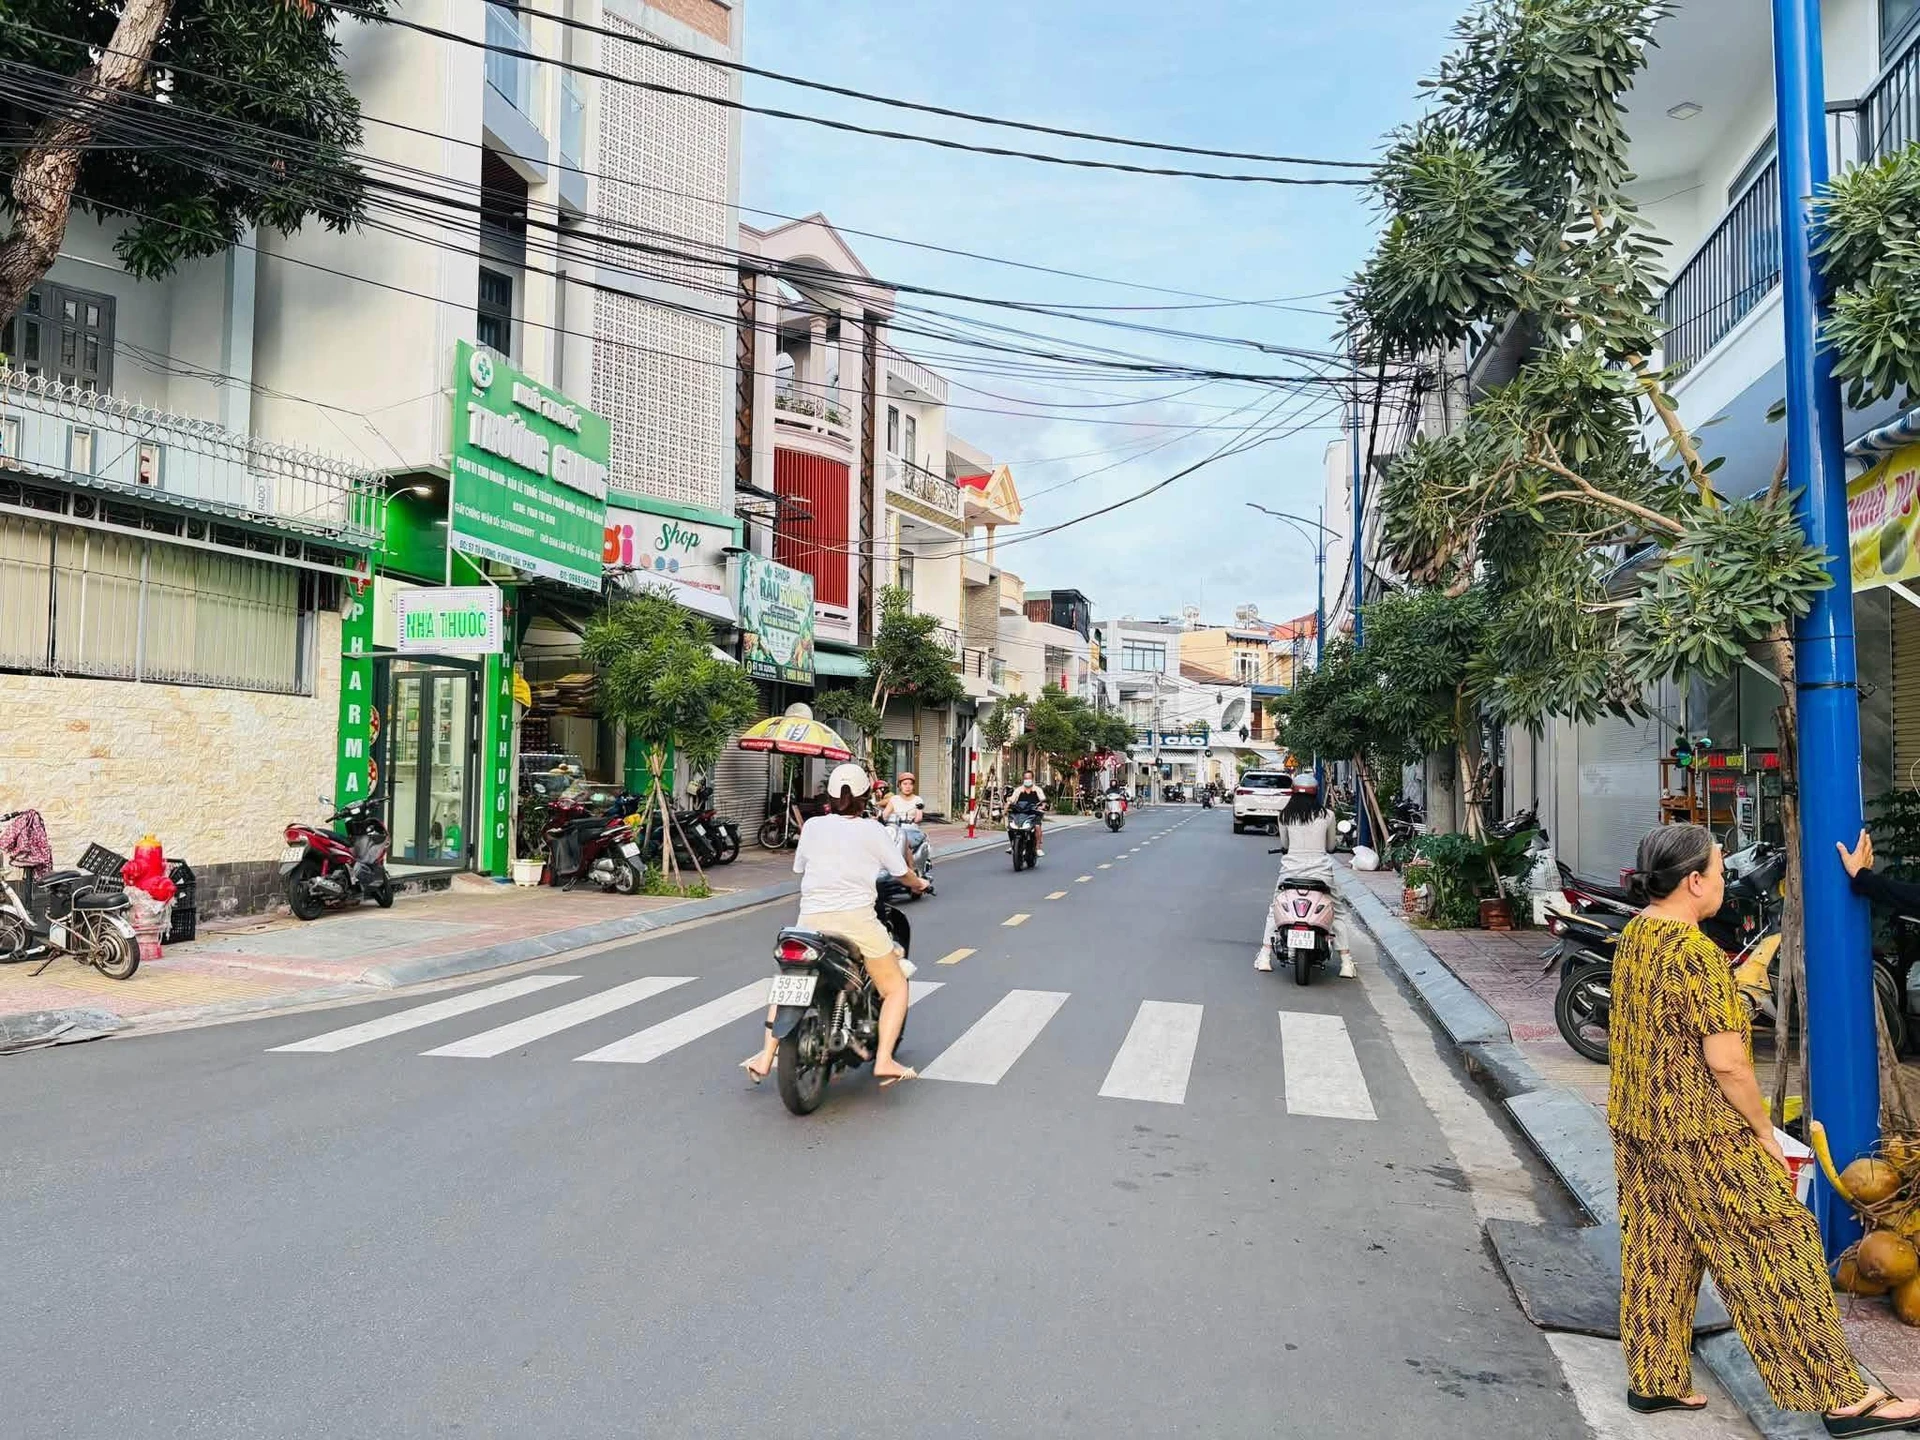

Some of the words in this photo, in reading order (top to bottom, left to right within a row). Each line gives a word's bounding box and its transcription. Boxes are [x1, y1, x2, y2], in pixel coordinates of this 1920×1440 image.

[655, 521, 702, 554] Shop
[439, 602, 487, 639] THUỐC
[344, 602, 365, 793] PHARMA
